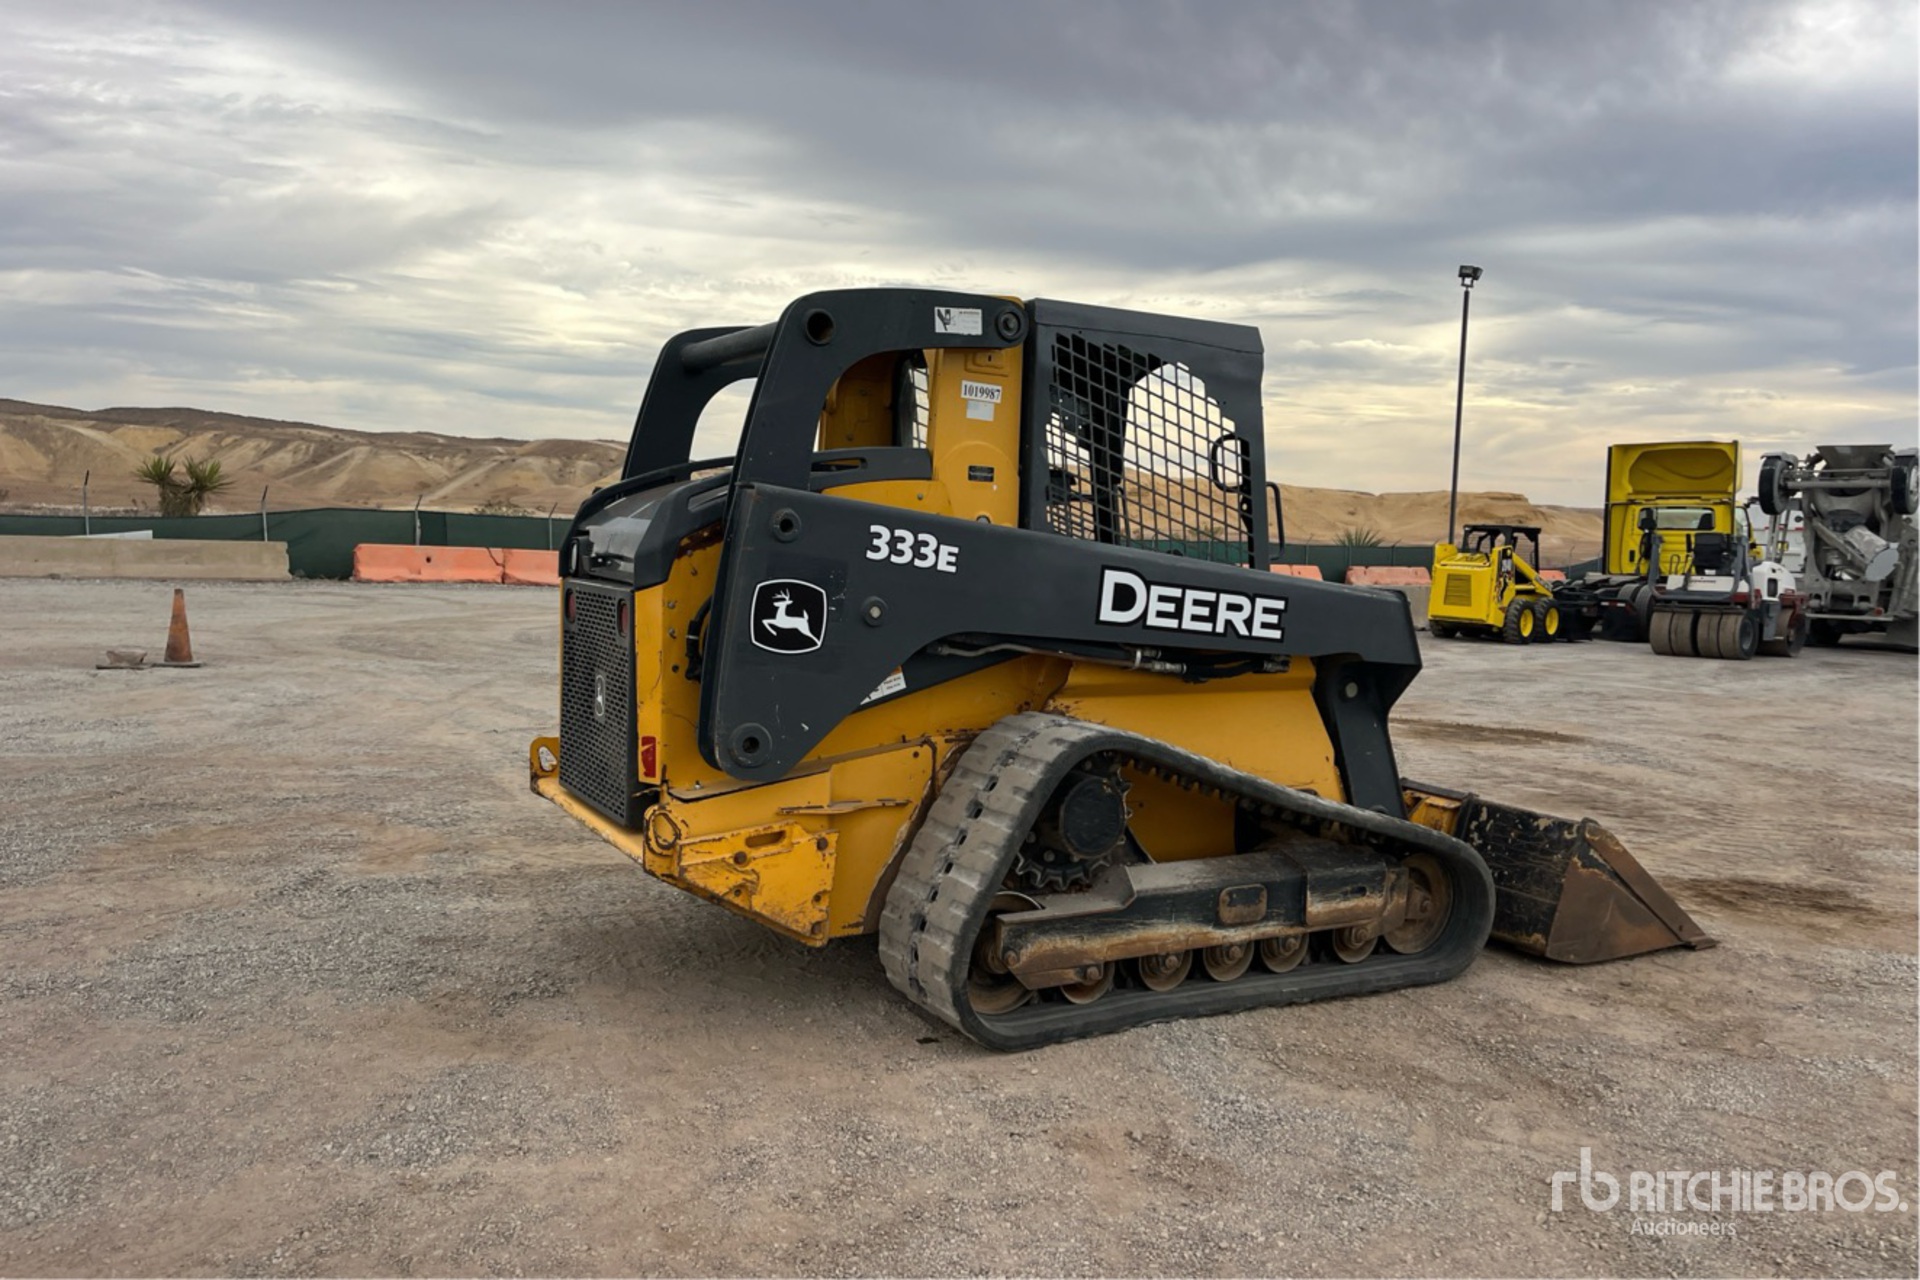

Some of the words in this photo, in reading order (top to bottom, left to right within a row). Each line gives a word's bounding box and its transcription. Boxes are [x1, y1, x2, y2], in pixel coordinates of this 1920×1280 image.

[963, 383, 1001, 400] 1019987
[866, 524, 959, 573] 333E
[1099, 569, 1286, 640] DEERE
